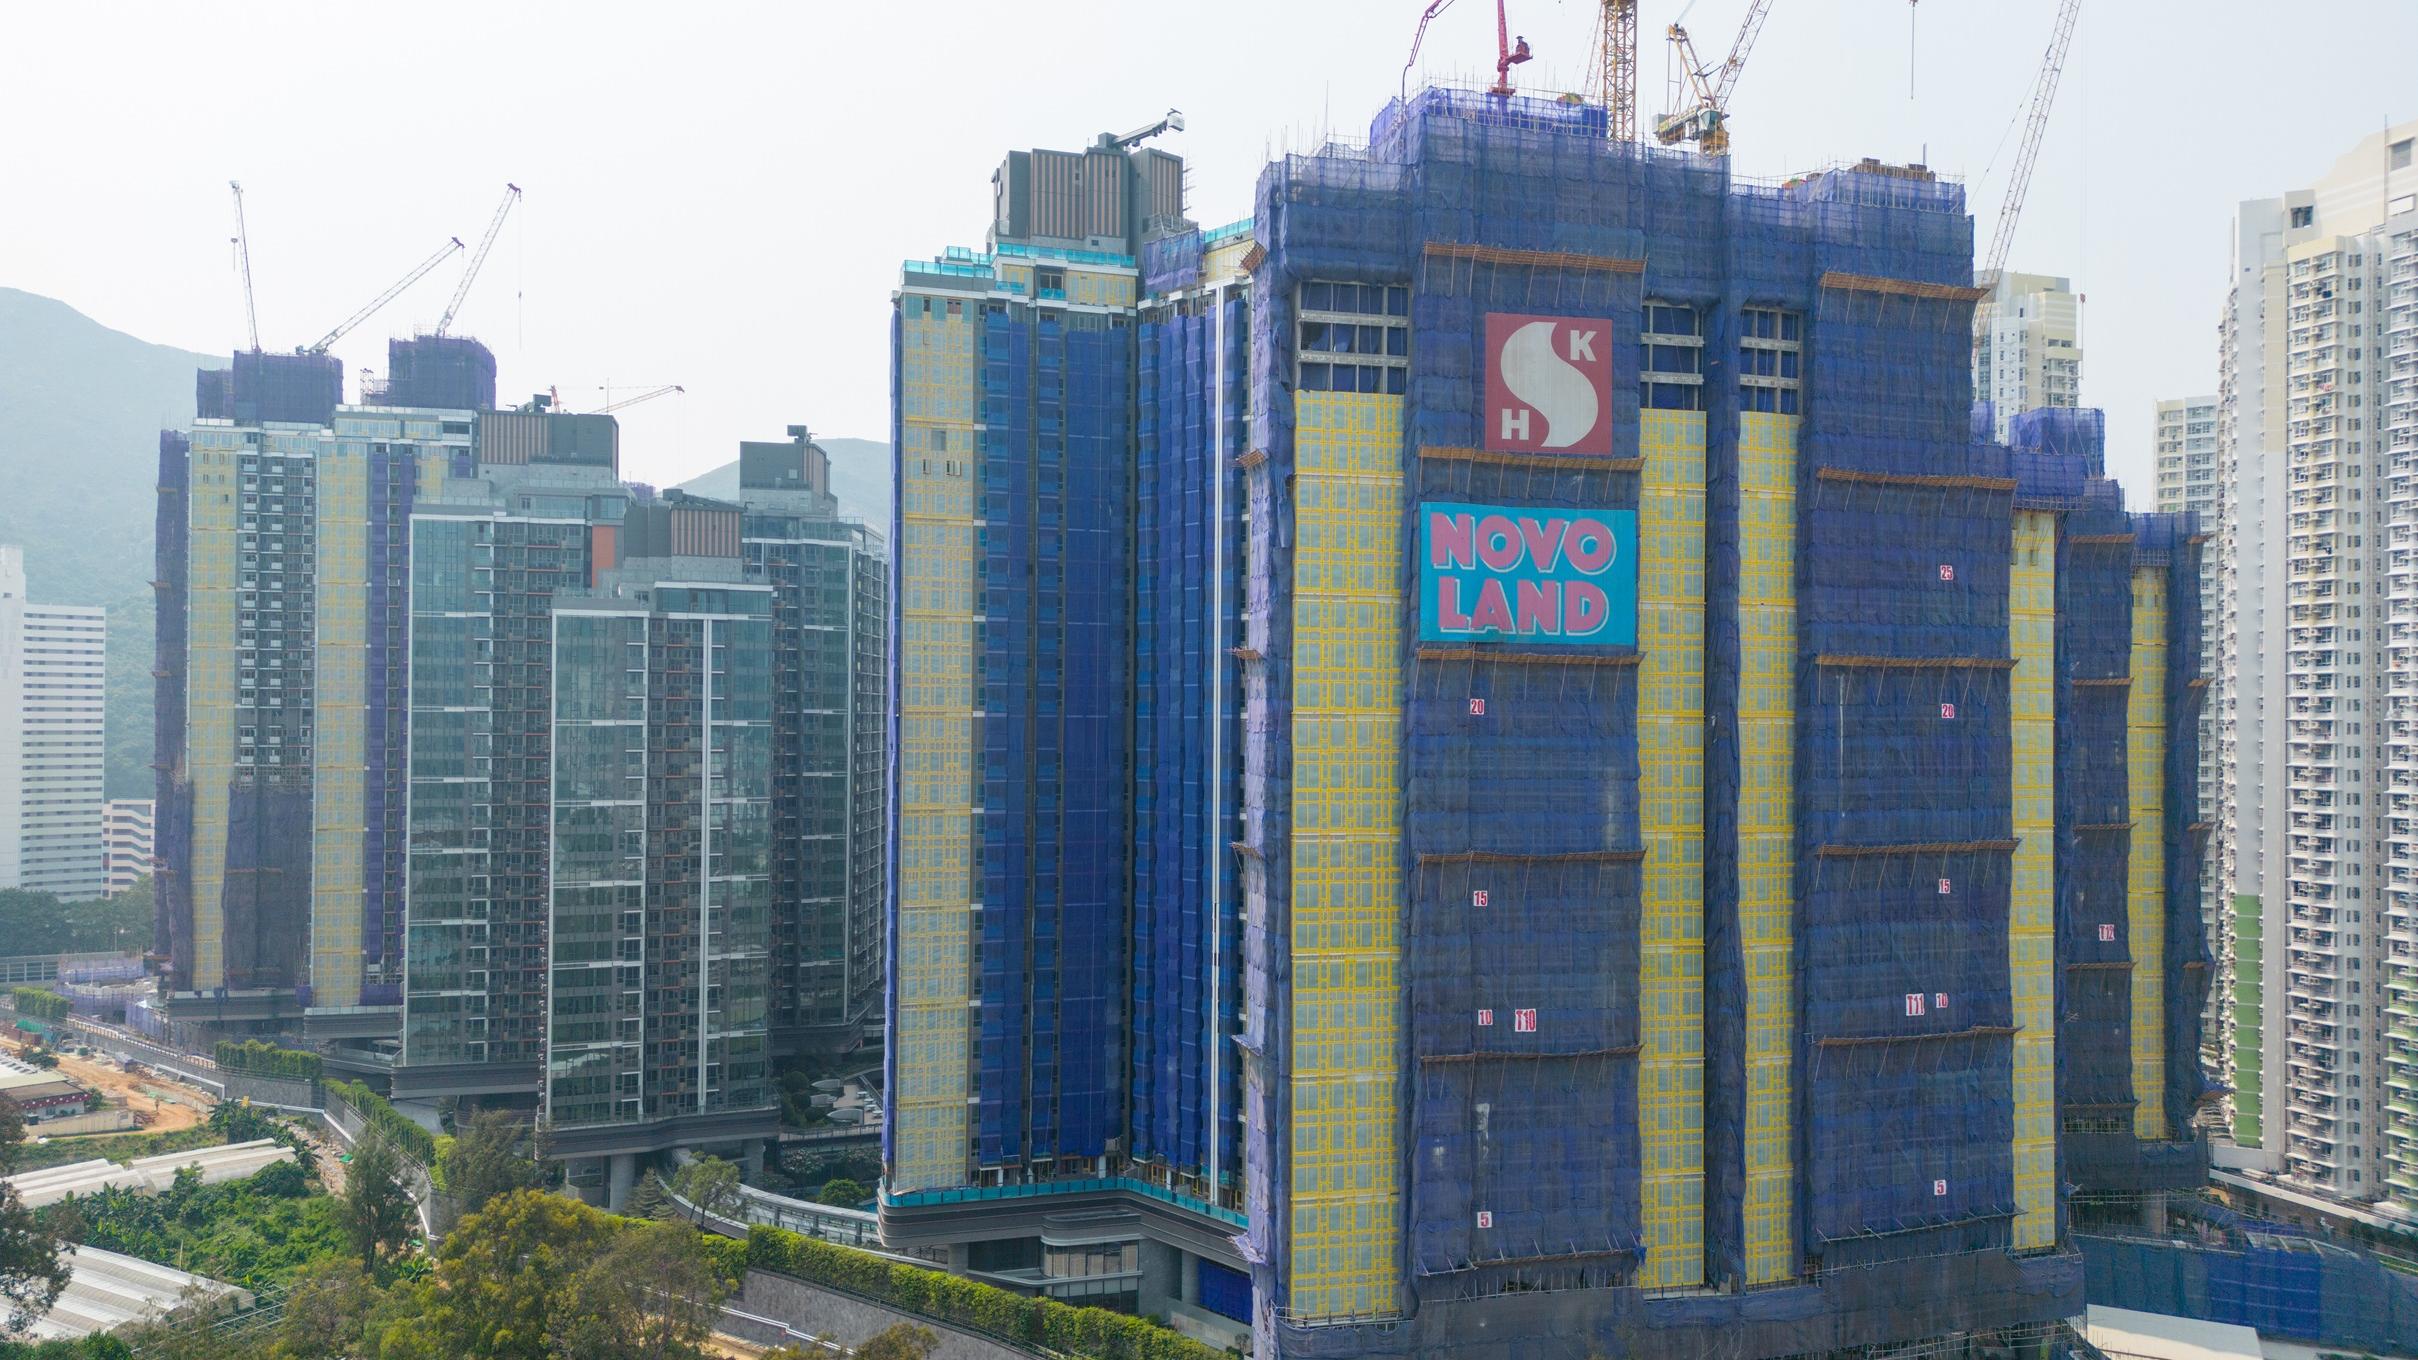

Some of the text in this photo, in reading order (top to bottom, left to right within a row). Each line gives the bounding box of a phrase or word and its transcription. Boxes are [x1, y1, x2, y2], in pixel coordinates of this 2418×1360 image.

[1570, 329, 1598, 362] K
[1500, 321, 1598, 447] S
[1501, 408, 1530, 441] H
[1430, 511, 1617, 575] NOVO
[1941, 565, 1953, 580] 25
[1438, 575, 1610, 636] LAND
[1471, 699, 1485, 715] 20
[1942, 704, 1954, 718] 20
[1939, 879, 1950, 894] 15
[1474, 891, 1488, 906] 15
[2099, 925, 2115, 940] T12
[1906, 994, 1924, 1015] T11
[1937, 994, 1948, 1008] 10
[1479, 1010, 1492, 1025] 10
[1515, 1009, 1536, 1031] T10
[1935, 1181, 1945, 1195] 5
[1479, 1212, 1490, 1227] 5
